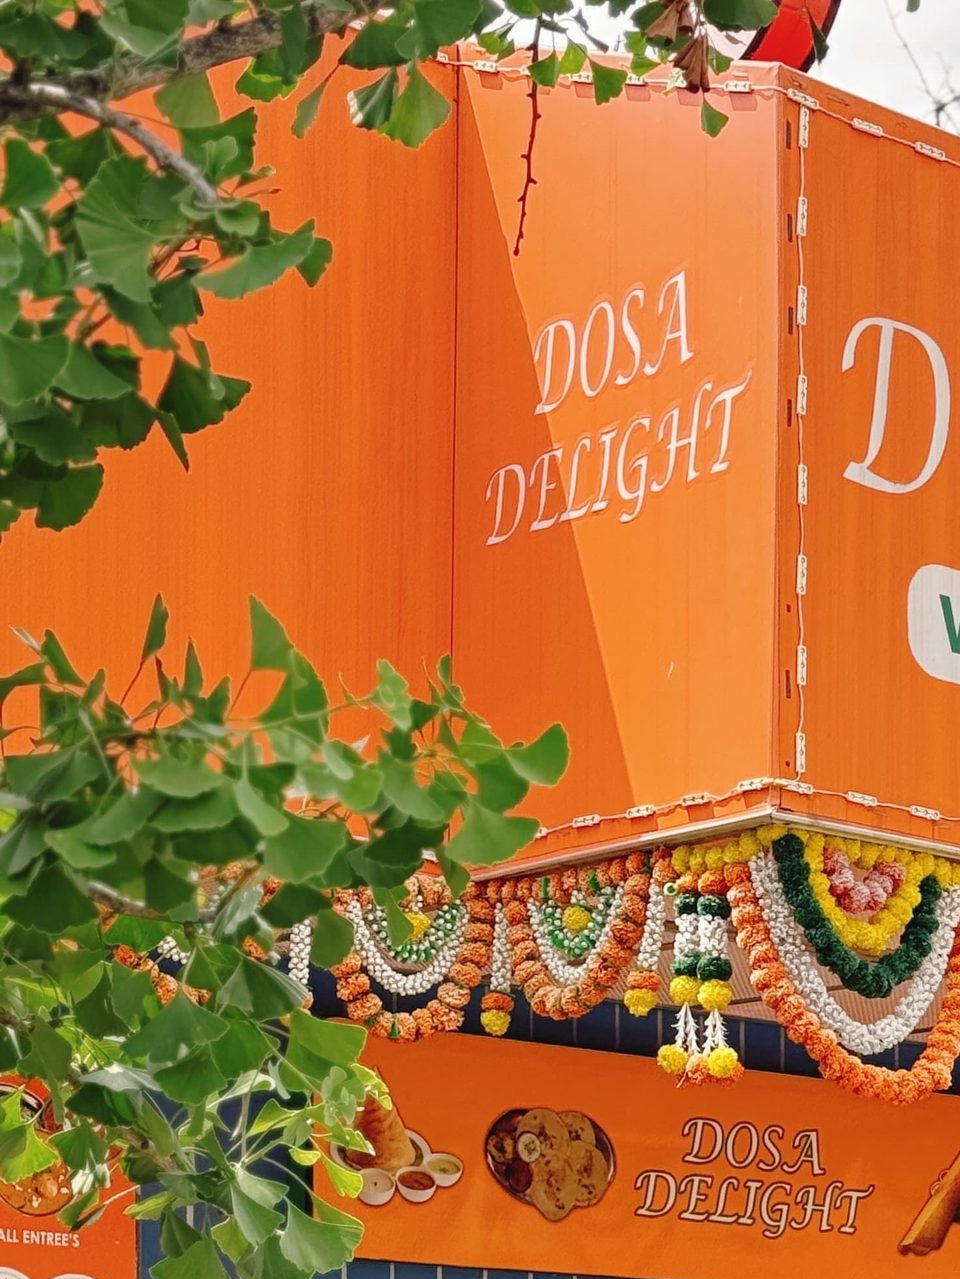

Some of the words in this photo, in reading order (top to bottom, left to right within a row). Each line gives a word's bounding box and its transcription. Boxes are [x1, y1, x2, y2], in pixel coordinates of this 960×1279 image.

[534, 269, 694, 415] DOSA
[485, 369, 753, 546] DELIGHT
[682, 1116, 826, 1176] DOSA
[23, 1230, 80, 1248] ENTREE'S
[634, 1169, 876, 1240] DELIGHT
